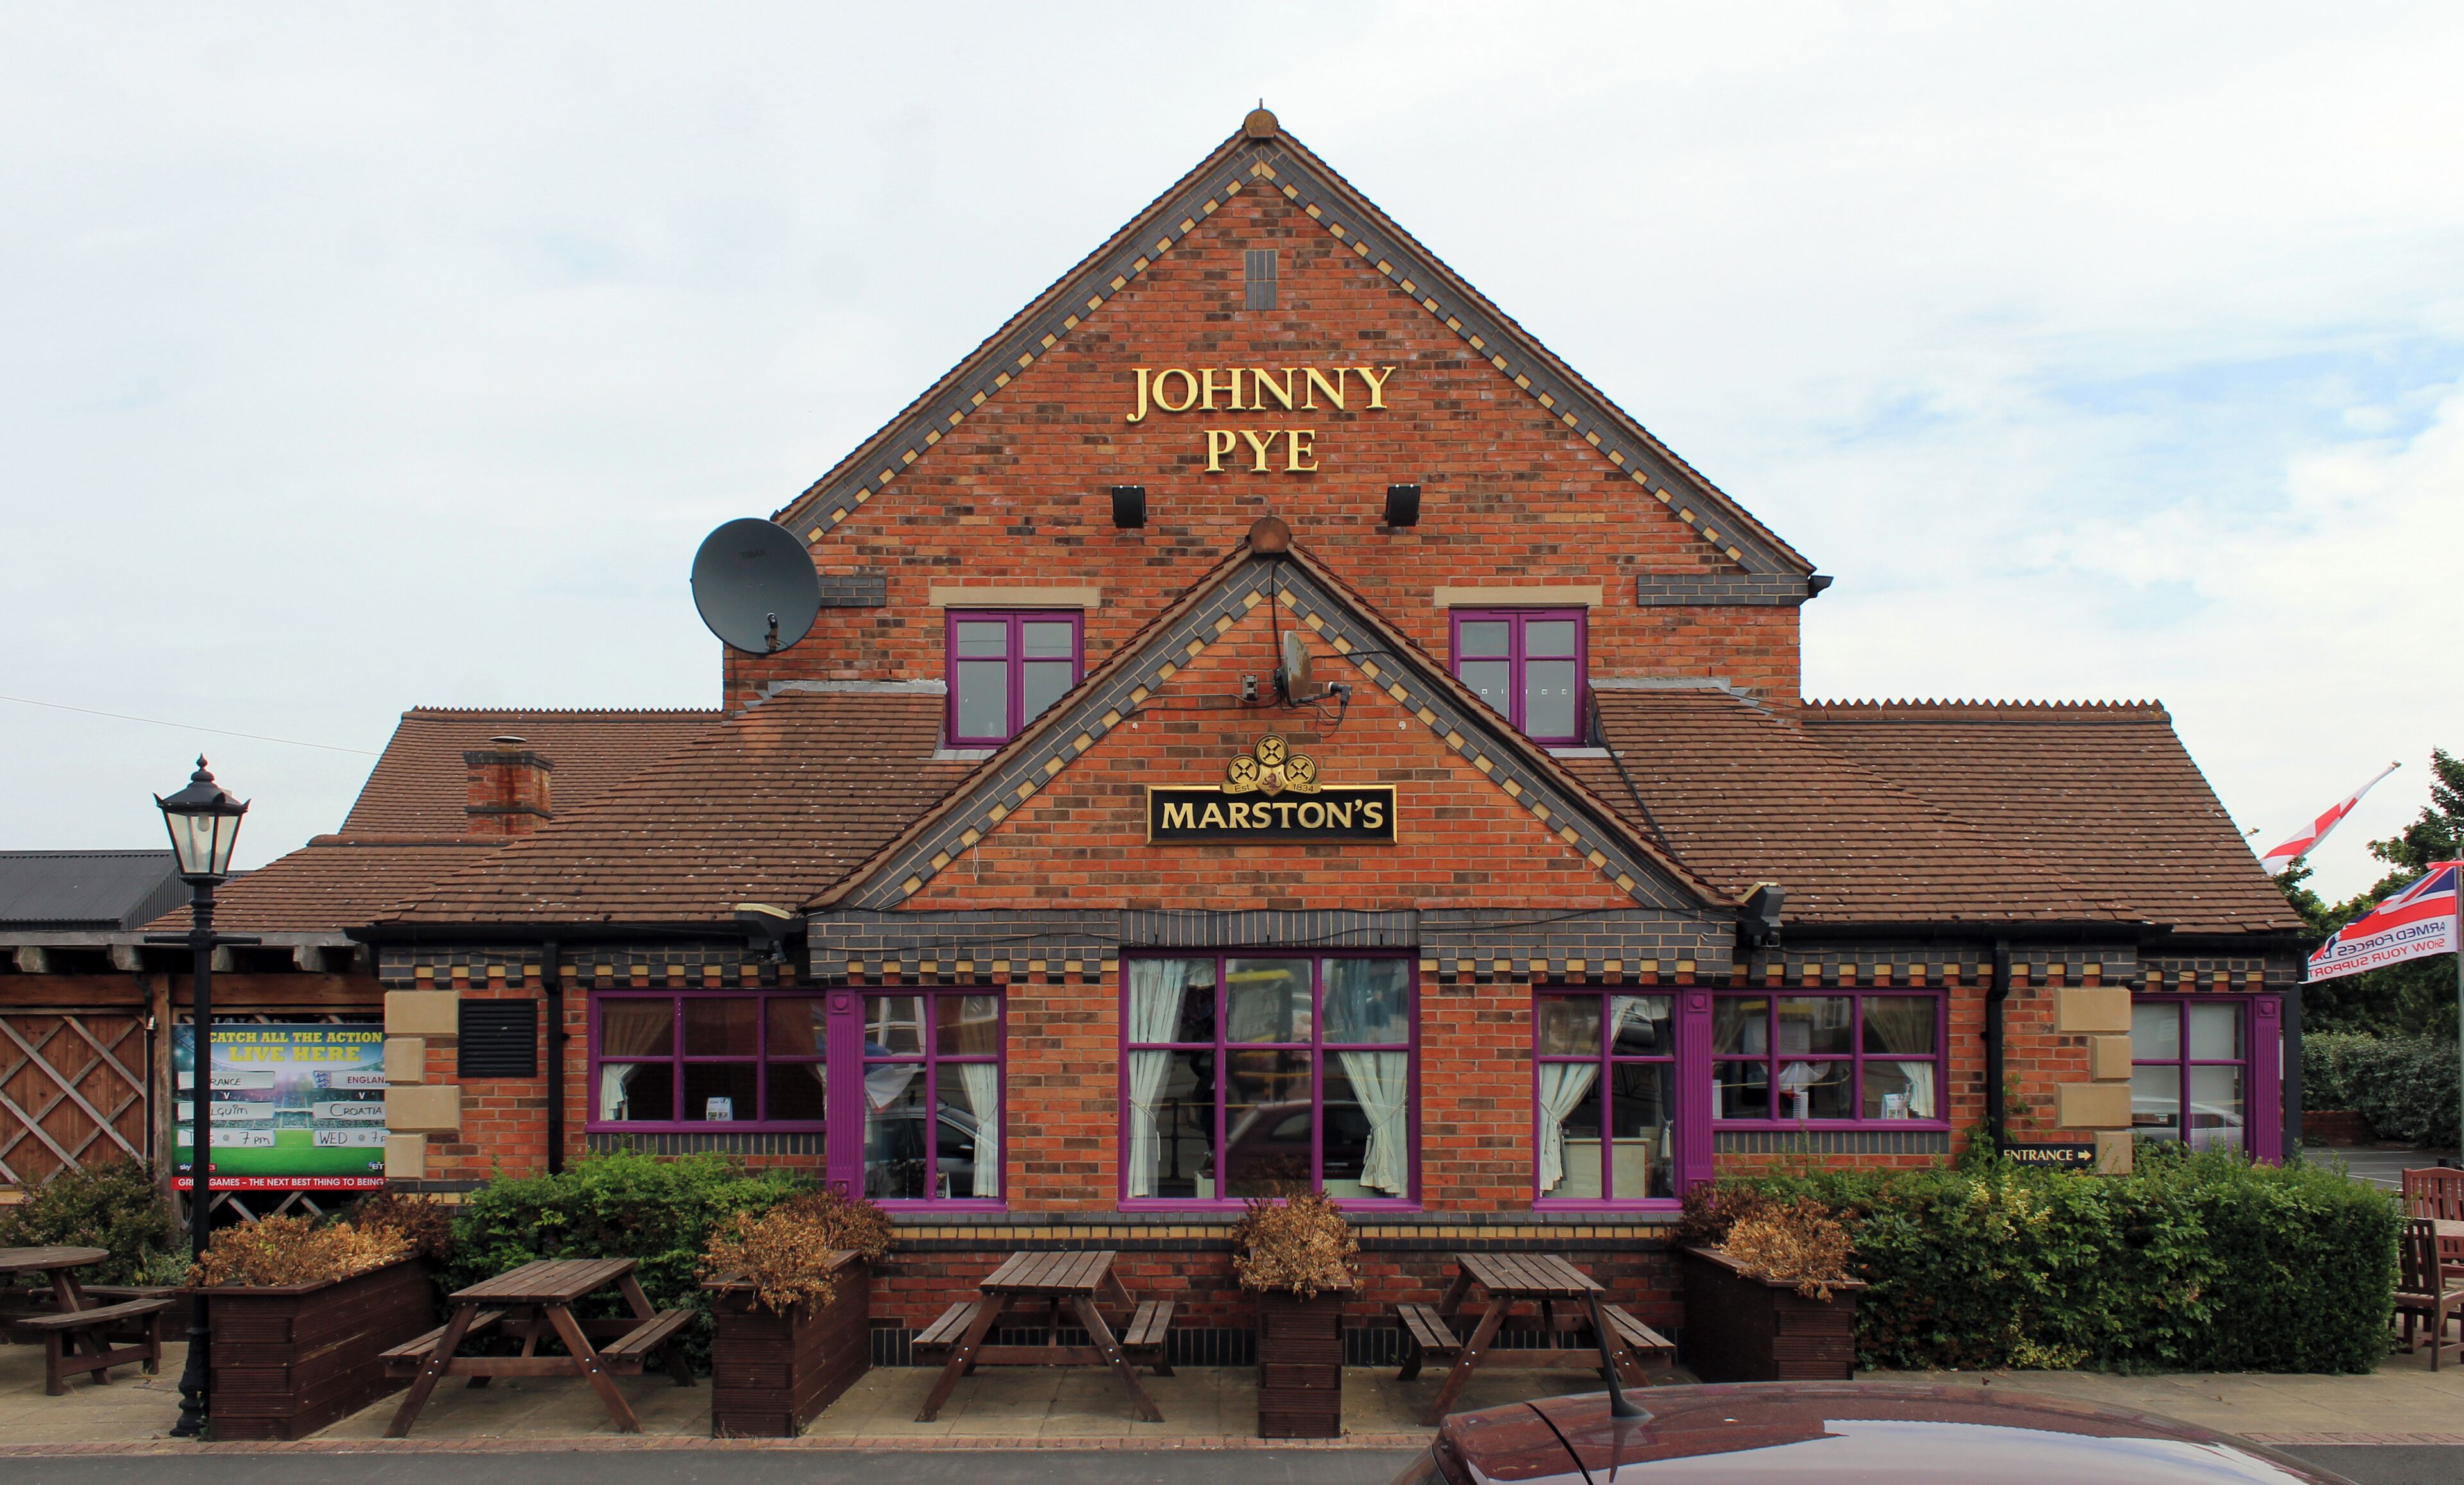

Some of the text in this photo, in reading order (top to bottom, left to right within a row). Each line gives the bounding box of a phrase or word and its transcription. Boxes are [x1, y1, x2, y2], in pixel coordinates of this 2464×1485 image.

[1126, 366, 1396, 424] JOHNNY
[1204, 429, 1319, 473] PYE
[1161, 799, 1383, 829] MARSTON'S
[210, 1032, 382, 1043] CATCH ALL THE ACTION
[228, 1046, 361, 1061] LIVE HERE
[320, 1131, 348, 1145] WED
[2003, 1149, 2073, 1161] ENTRANCE
[209, 1178, 240, 1187] GAMES
